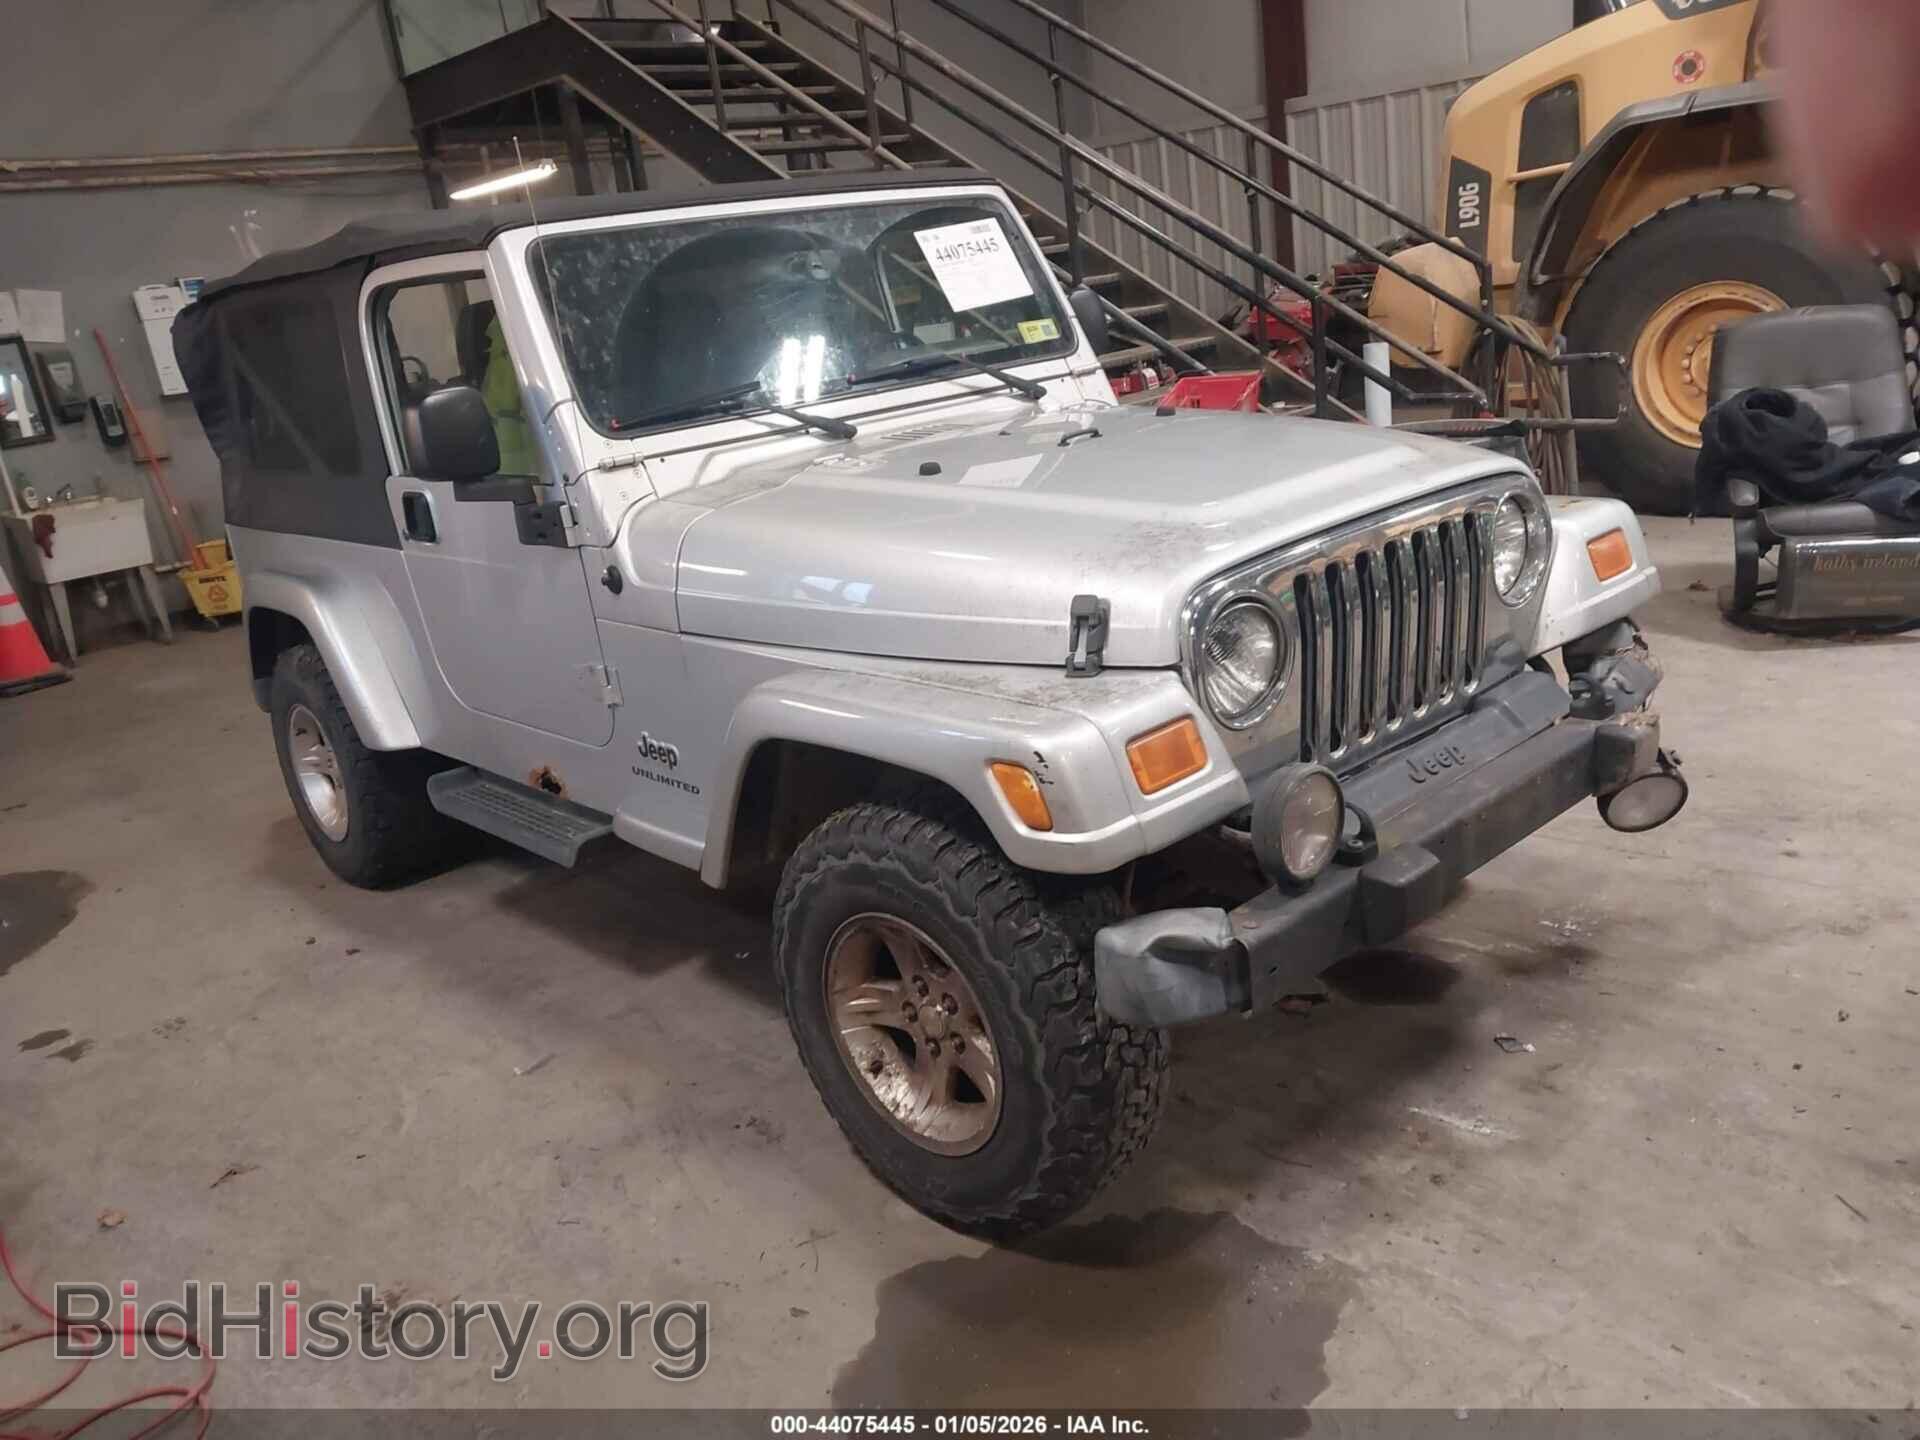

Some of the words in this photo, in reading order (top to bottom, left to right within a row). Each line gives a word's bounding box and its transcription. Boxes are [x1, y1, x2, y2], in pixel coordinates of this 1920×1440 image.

[1459, 182, 1480, 228] L90G
[936, 237, 999, 262] 44075445
[638, 731, 679, 770] Jeep
[1406, 745, 1466, 783] Jeep
[632, 765, 701, 795] UNLIMITED
